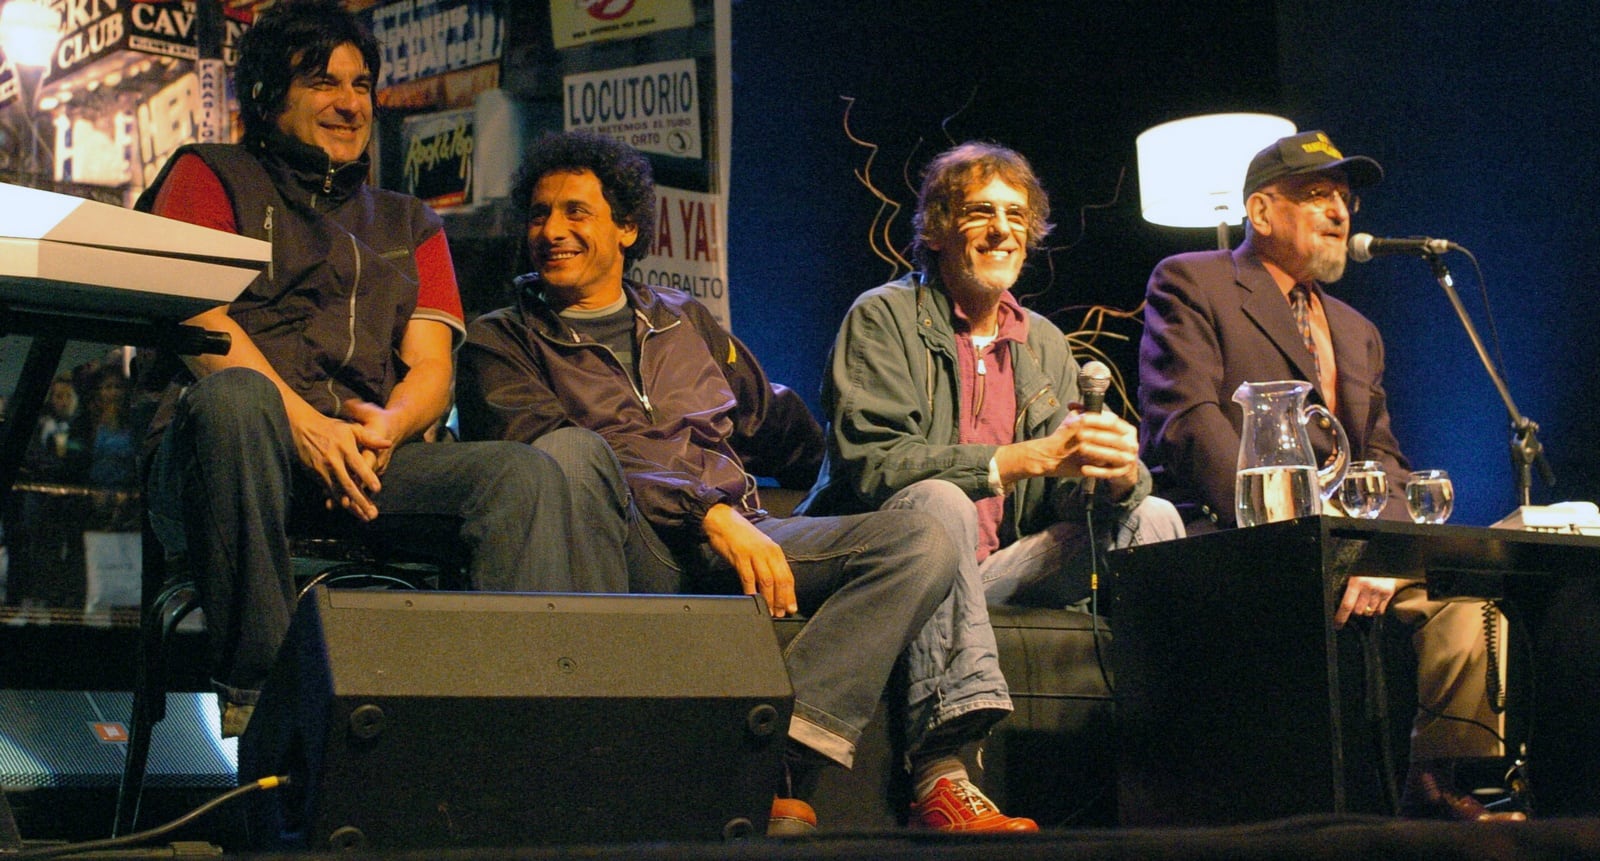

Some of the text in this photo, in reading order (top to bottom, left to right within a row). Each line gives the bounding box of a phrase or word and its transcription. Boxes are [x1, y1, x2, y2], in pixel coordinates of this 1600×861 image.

[58, 12, 124, 69] CLUB
[568, 72, 692, 125] LOCUTORIO
[631, 132, 660, 146] ORTO
[679, 199, 718, 263] YA!
[647, 270, 723, 299] COBALTO
